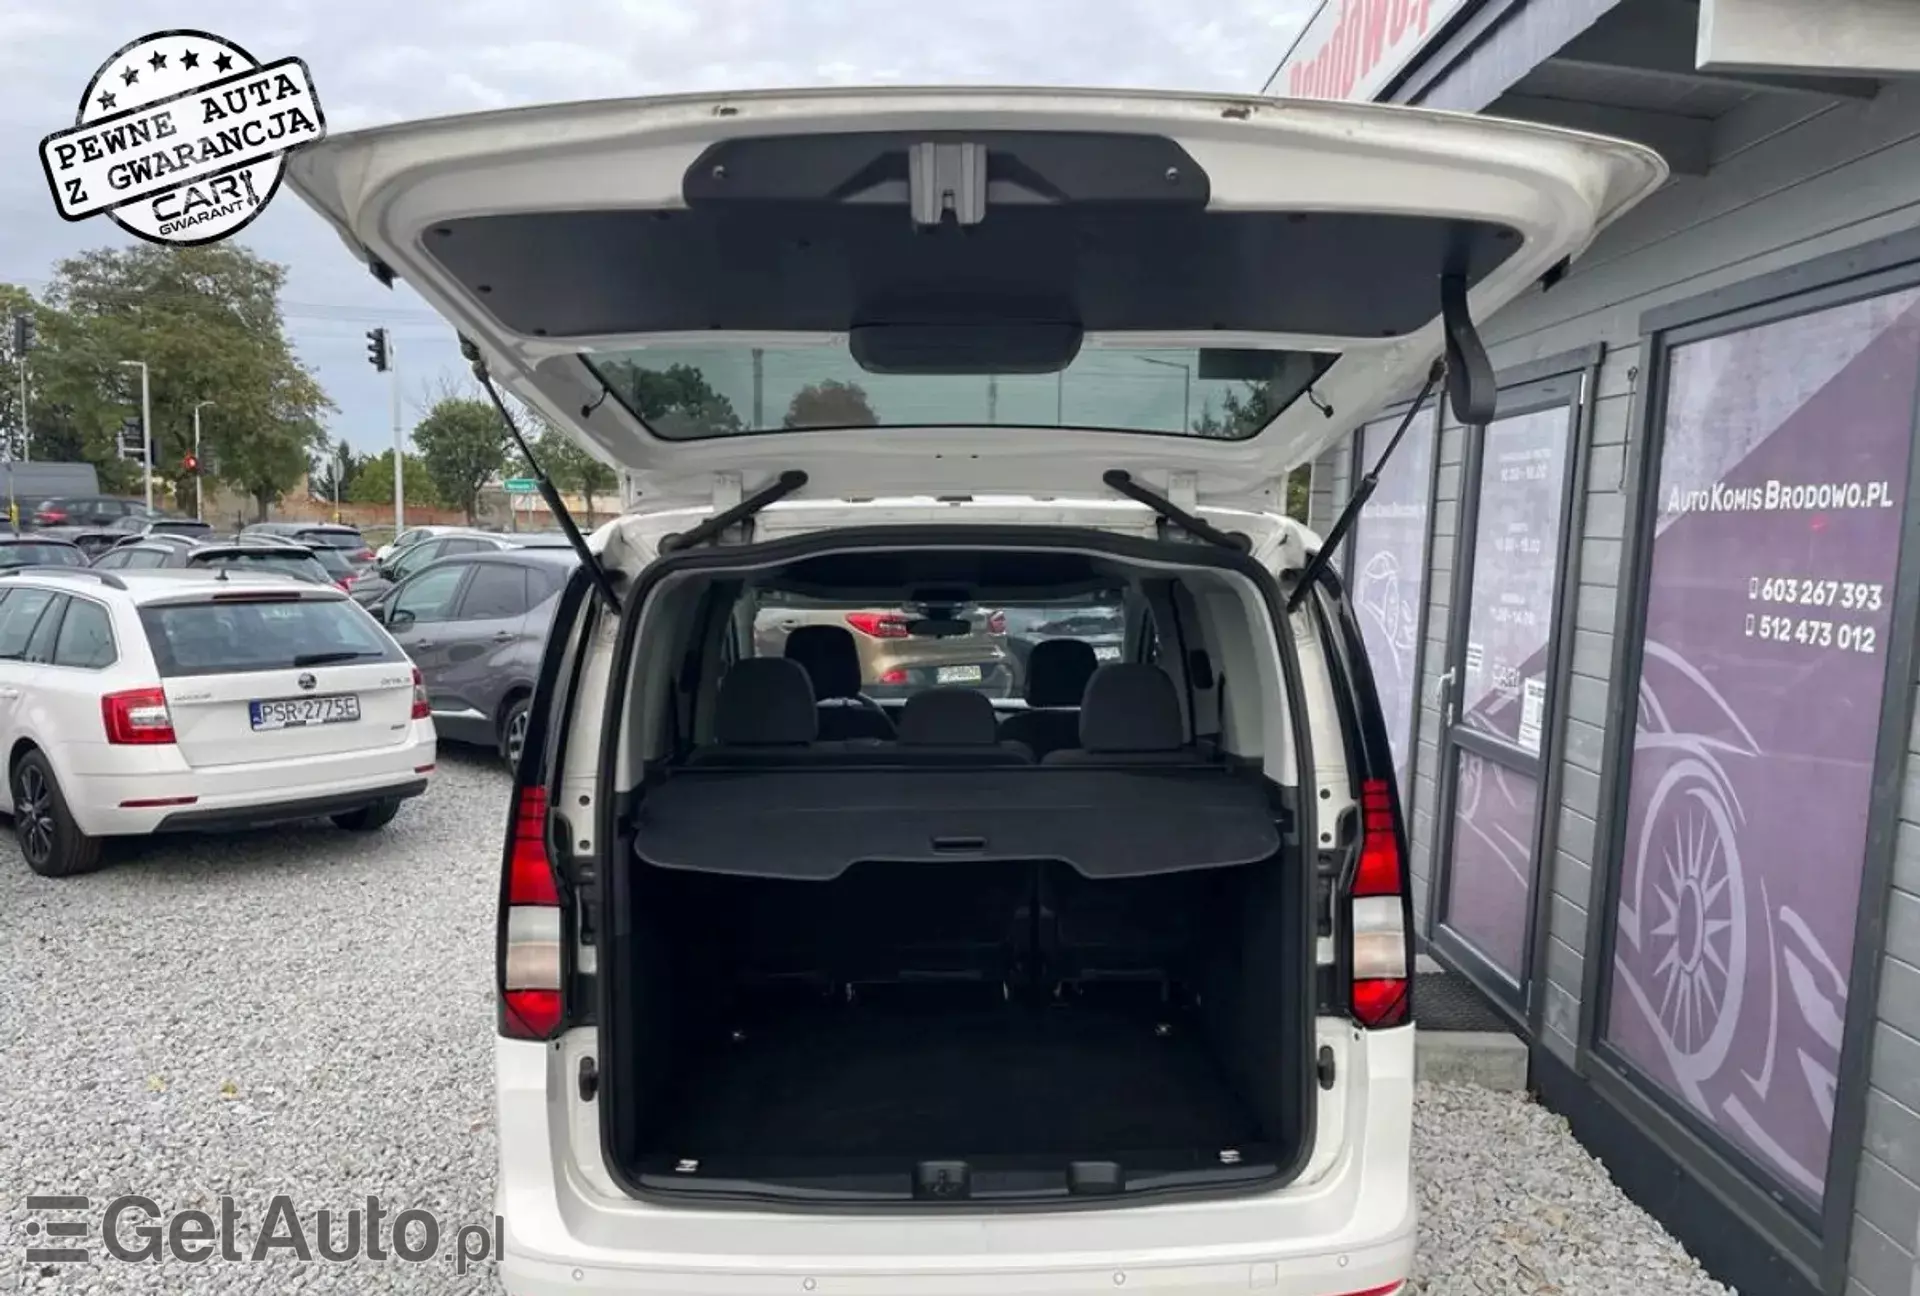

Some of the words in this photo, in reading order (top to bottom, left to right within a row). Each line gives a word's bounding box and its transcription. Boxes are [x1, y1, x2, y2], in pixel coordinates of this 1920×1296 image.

[1761, 577, 1798, 602] 603
[1800, 579, 1838, 607] 267
[1841, 582, 1883, 611] 393
[1759, 615, 1792, 642] 512
[1795, 620, 1833, 646] 473
[1837, 624, 1876, 653] 012
[262, 702, 297, 723] PSR
